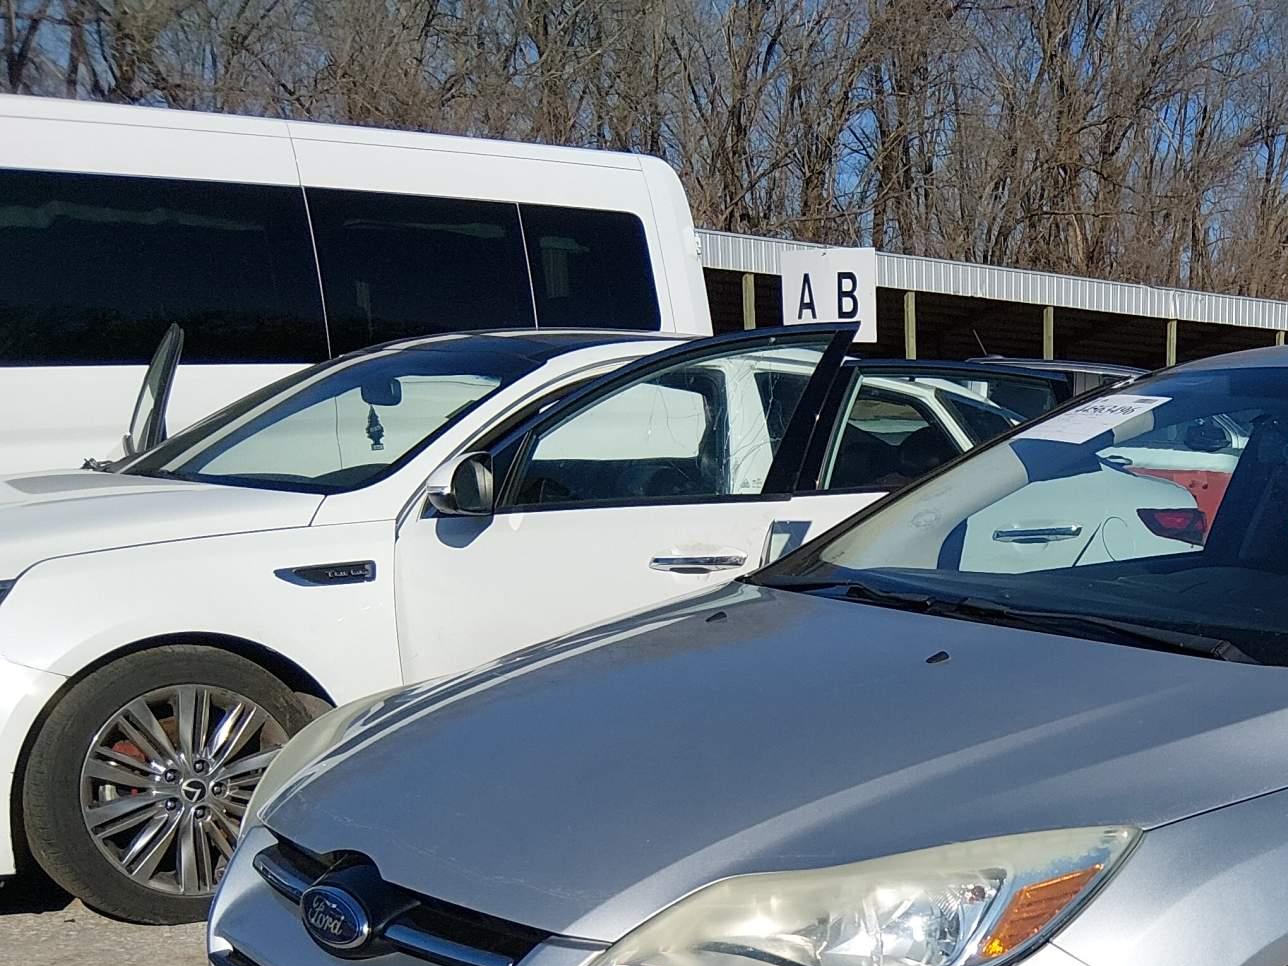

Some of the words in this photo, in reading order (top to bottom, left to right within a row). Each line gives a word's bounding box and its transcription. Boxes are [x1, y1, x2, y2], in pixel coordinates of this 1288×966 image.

[798, 273, 817, 320] A
[837, 271, 859, 319] B
[308, 896, 344, 935] Ford
